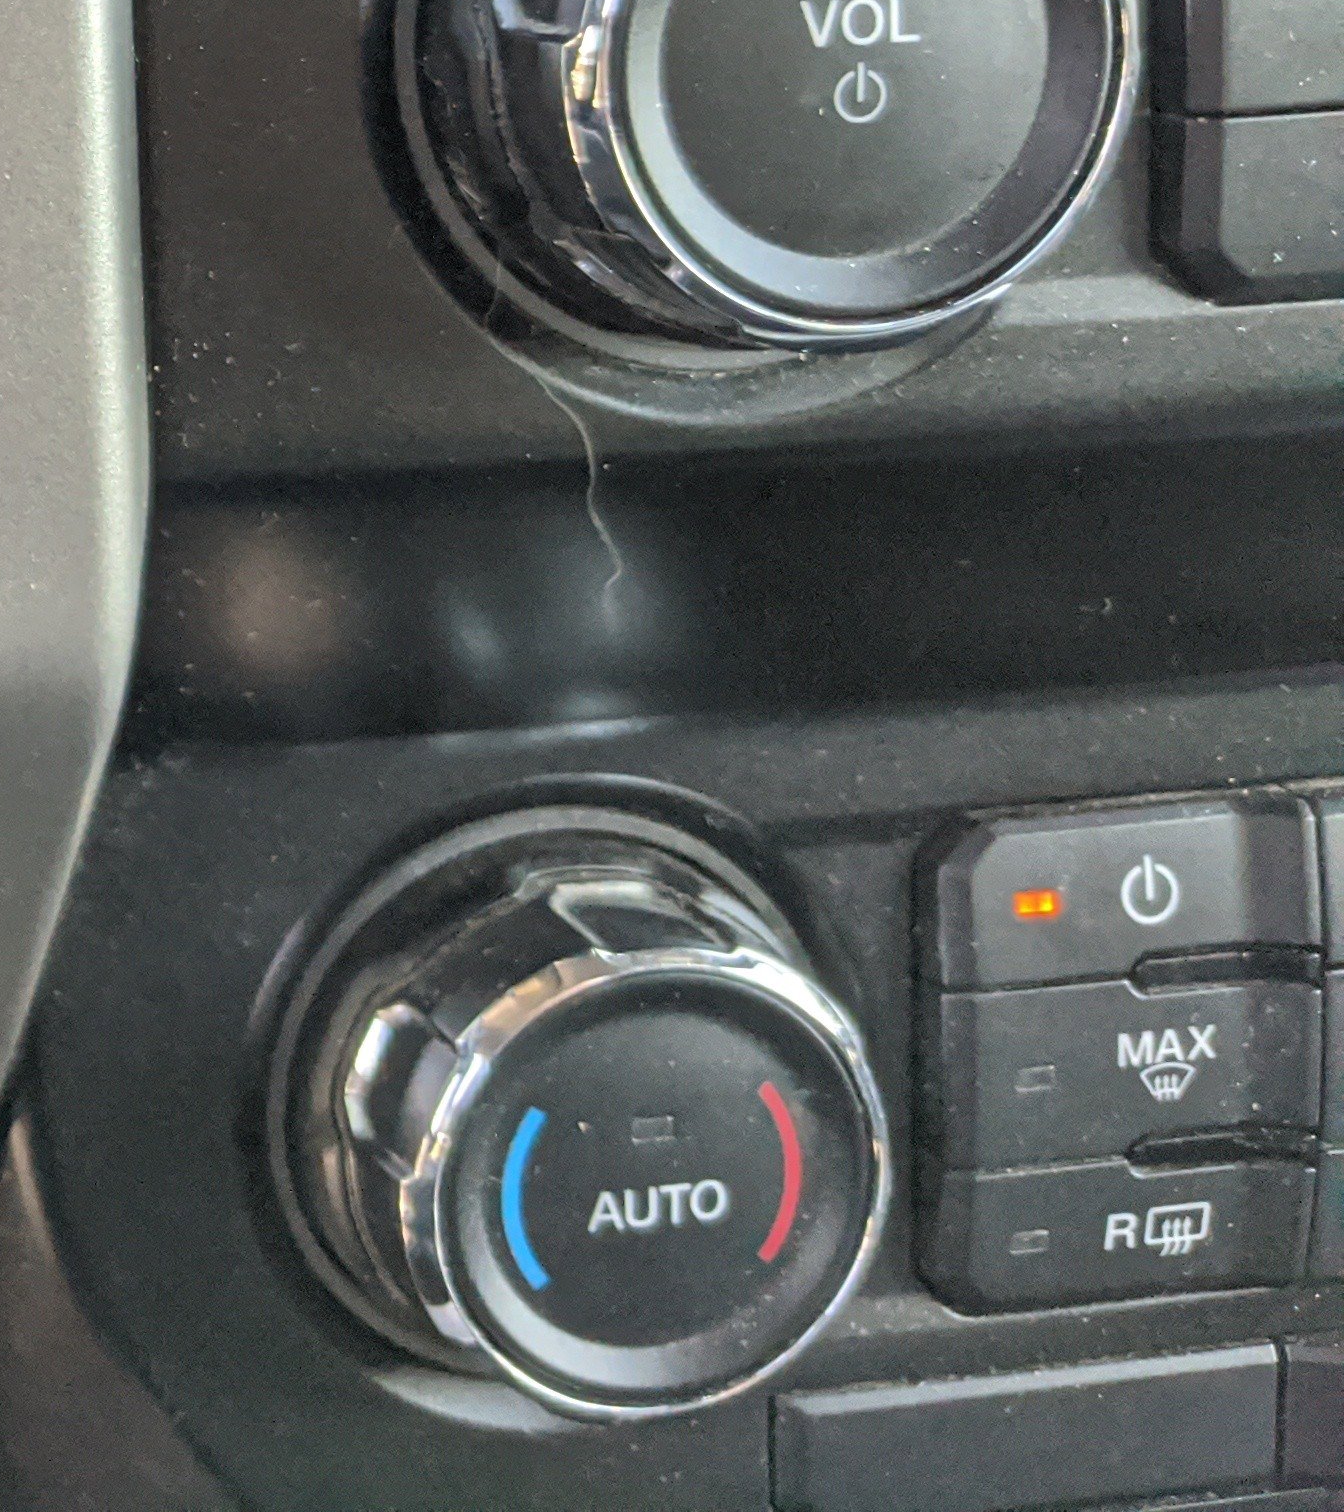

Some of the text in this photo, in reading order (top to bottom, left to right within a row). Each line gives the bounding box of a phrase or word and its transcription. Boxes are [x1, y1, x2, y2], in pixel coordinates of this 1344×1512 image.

[1117, 1024, 1218, 1068] MAX
[587, 1178, 729, 1234] AUTO
[1103, 1213, 1136, 1251] R
